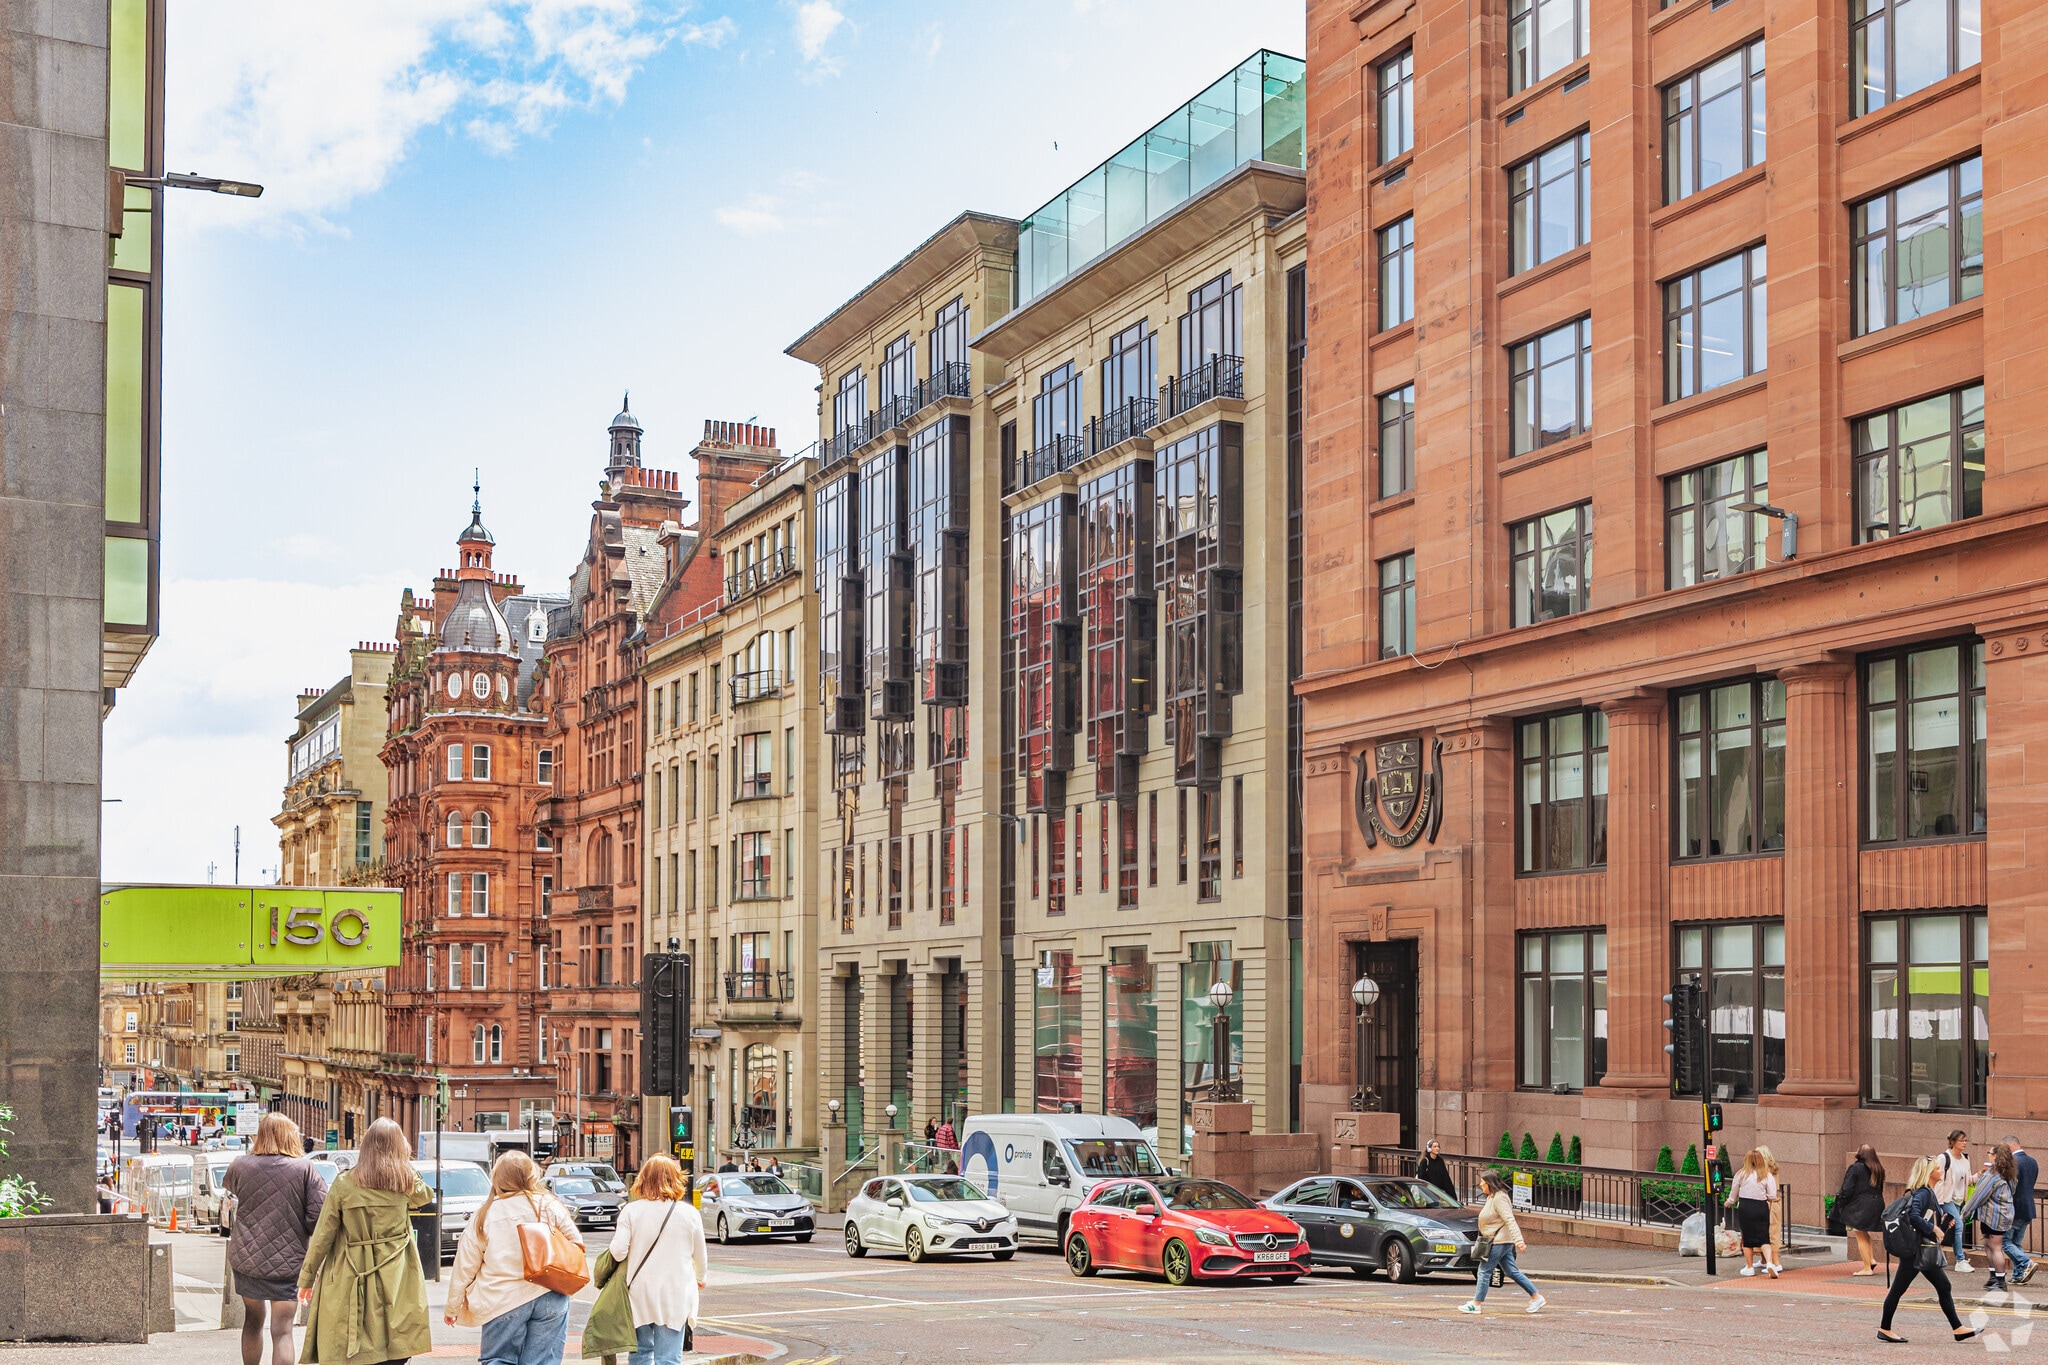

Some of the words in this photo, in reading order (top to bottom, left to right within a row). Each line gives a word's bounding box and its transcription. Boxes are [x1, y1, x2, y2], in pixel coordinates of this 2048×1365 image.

[1364, 794, 1374, 815] PER
[1371, 816, 1396, 845] CURAM
[1397, 786, 1431, 845] PLACEBIMUS
[269, 906, 371, 947] 150
[599, 1135, 613, 1144] LET
[1014, 1149, 1033, 1160] prohire
[1492, 1267, 1501, 1286] DKNY
